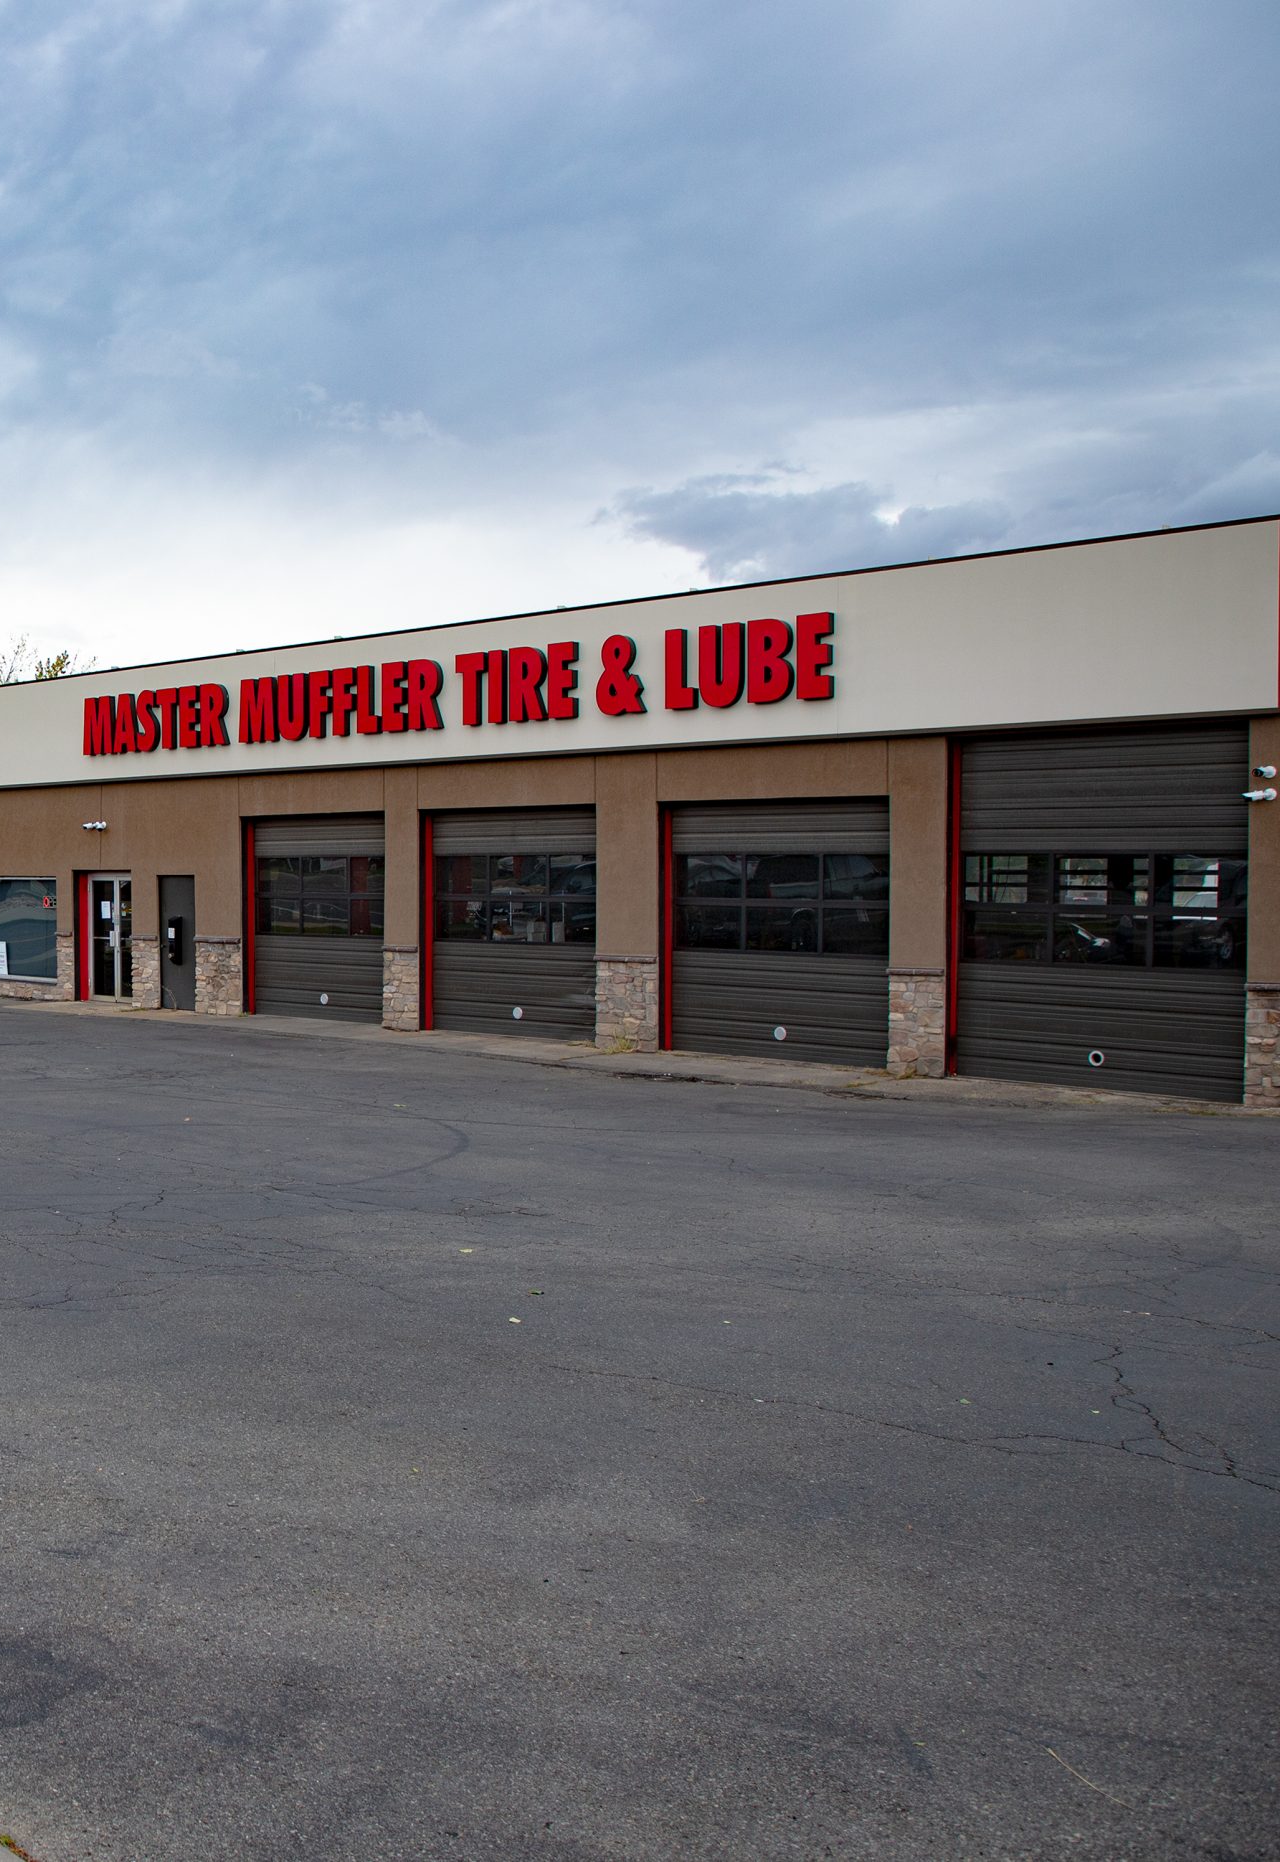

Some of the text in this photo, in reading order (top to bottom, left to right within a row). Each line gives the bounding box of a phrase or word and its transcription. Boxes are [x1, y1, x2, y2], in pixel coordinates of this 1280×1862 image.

[83, 611, 835, 757] MASTER MUFFLER TIRE & LUBE
